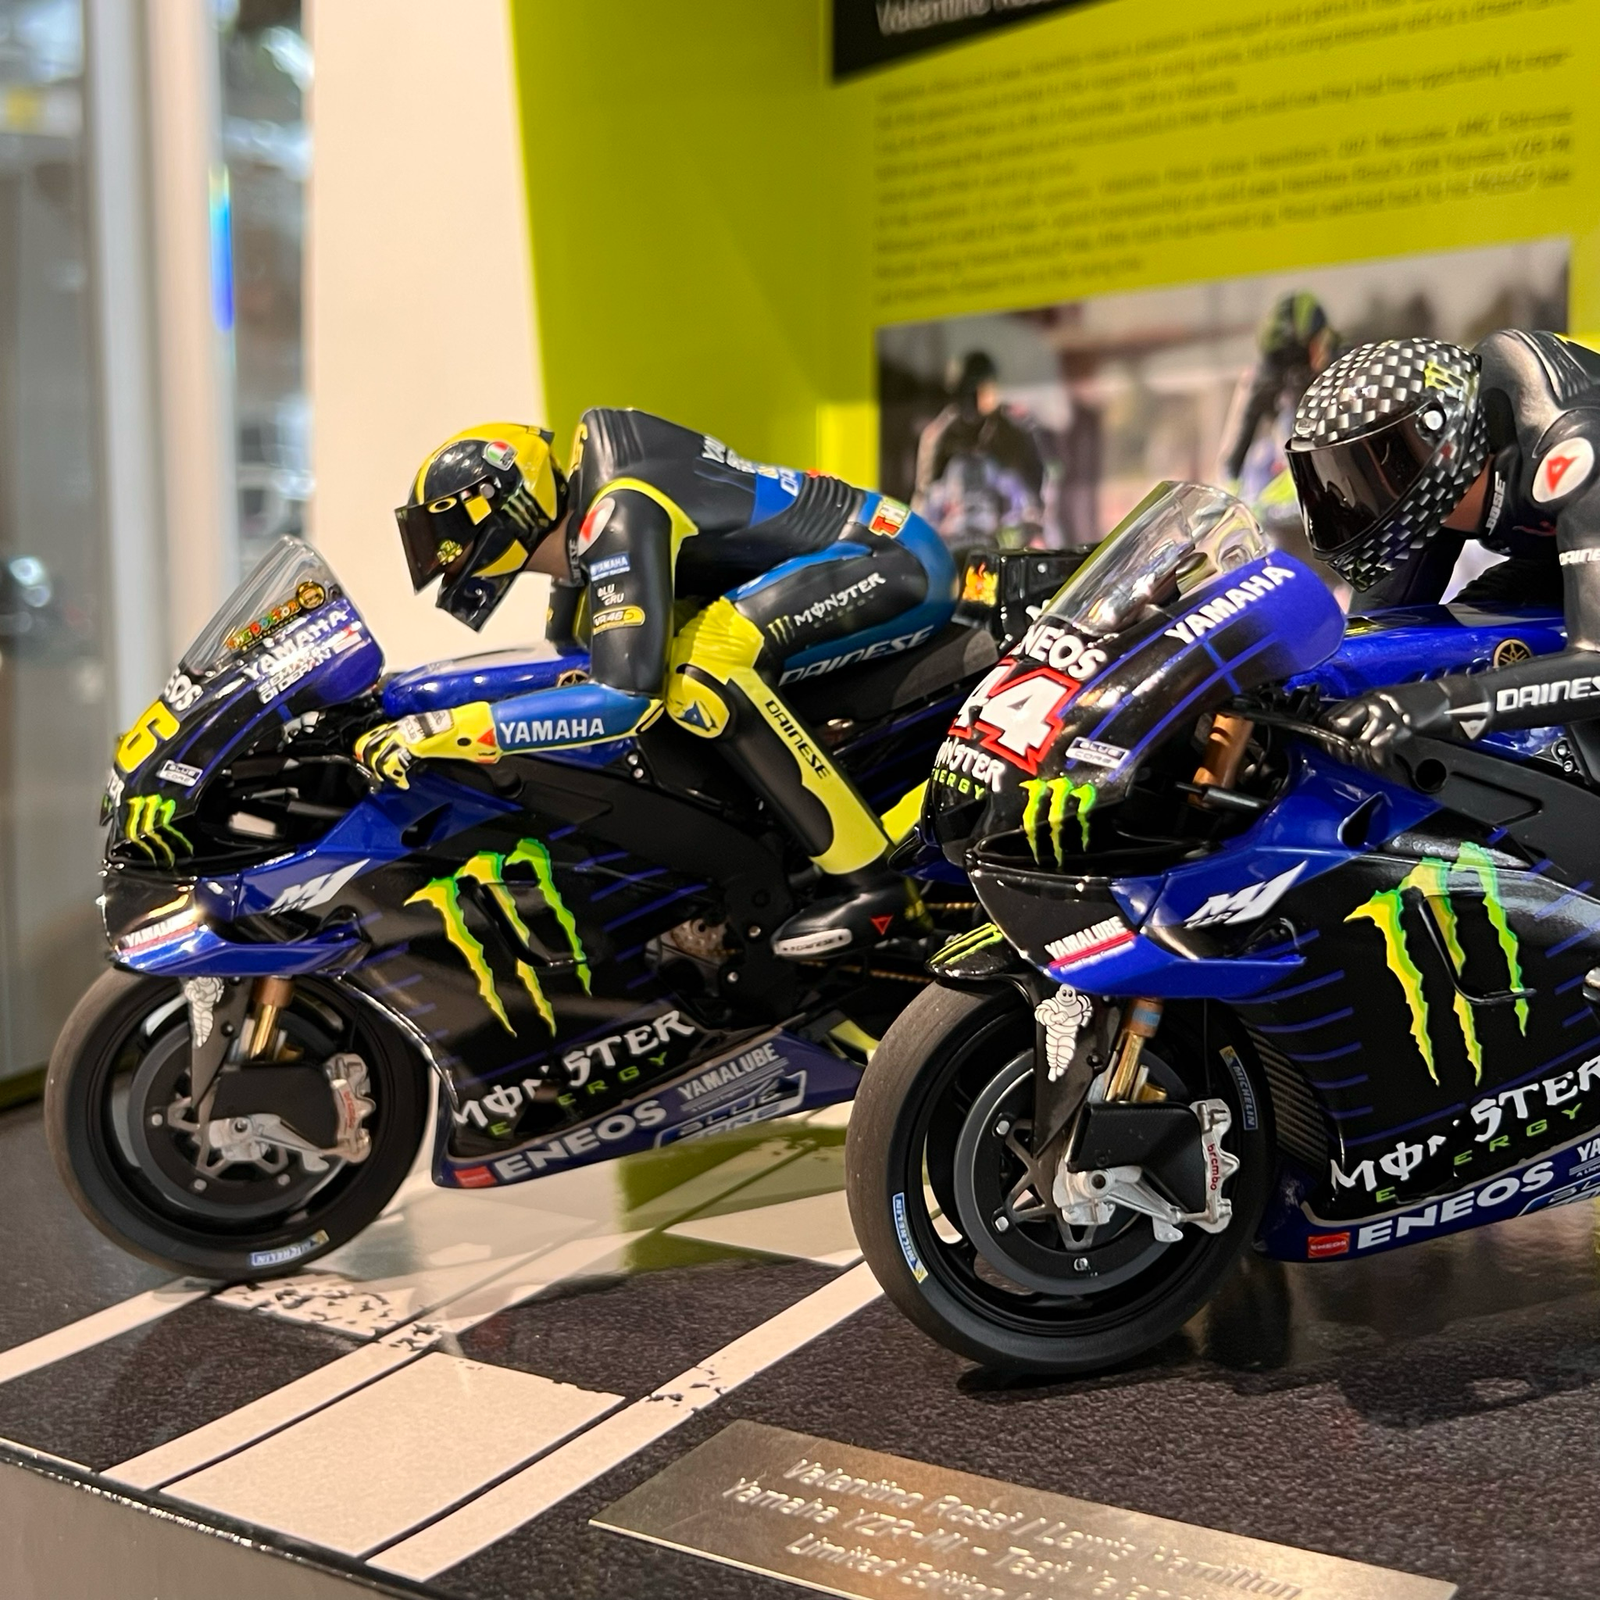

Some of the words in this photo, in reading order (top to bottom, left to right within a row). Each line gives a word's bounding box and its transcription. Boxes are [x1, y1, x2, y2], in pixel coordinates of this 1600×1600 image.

[1559, 548, 1600, 567] DAINE
[793, 572, 887, 626] MONSTER
[1164, 562, 1296, 646] YAMAHA
[242, 608, 350, 682] YAMAHA
[777, 624, 935, 688] DAINESE
[1009, 624, 1107, 681] NEOS
[1496, 677, 1600, 712] DAINES
[116, 700, 180, 774] 6
[500, 717, 605, 745] YAMAHA
[765, 699, 830, 780] DAINESE
[932, 768, 985, 800] NERGY
[1044, 915, 1128, 962] YAMALUBE
[490, 1052, 668, 1138] EERGY
[678, 1042, 780, 1101] YAMALUBE
[1233, 1065, 1257, 1127] MICHELIN
[494, 1100, 668, 1181] ENEOS
[1375, 1102, 1583, 1203] EERGY
[1357, 1161, 1554, 1250] ENEOS
[722, 1477, 840, 1524] Yamaha
[785, 1532, 898, 1578] Limited
